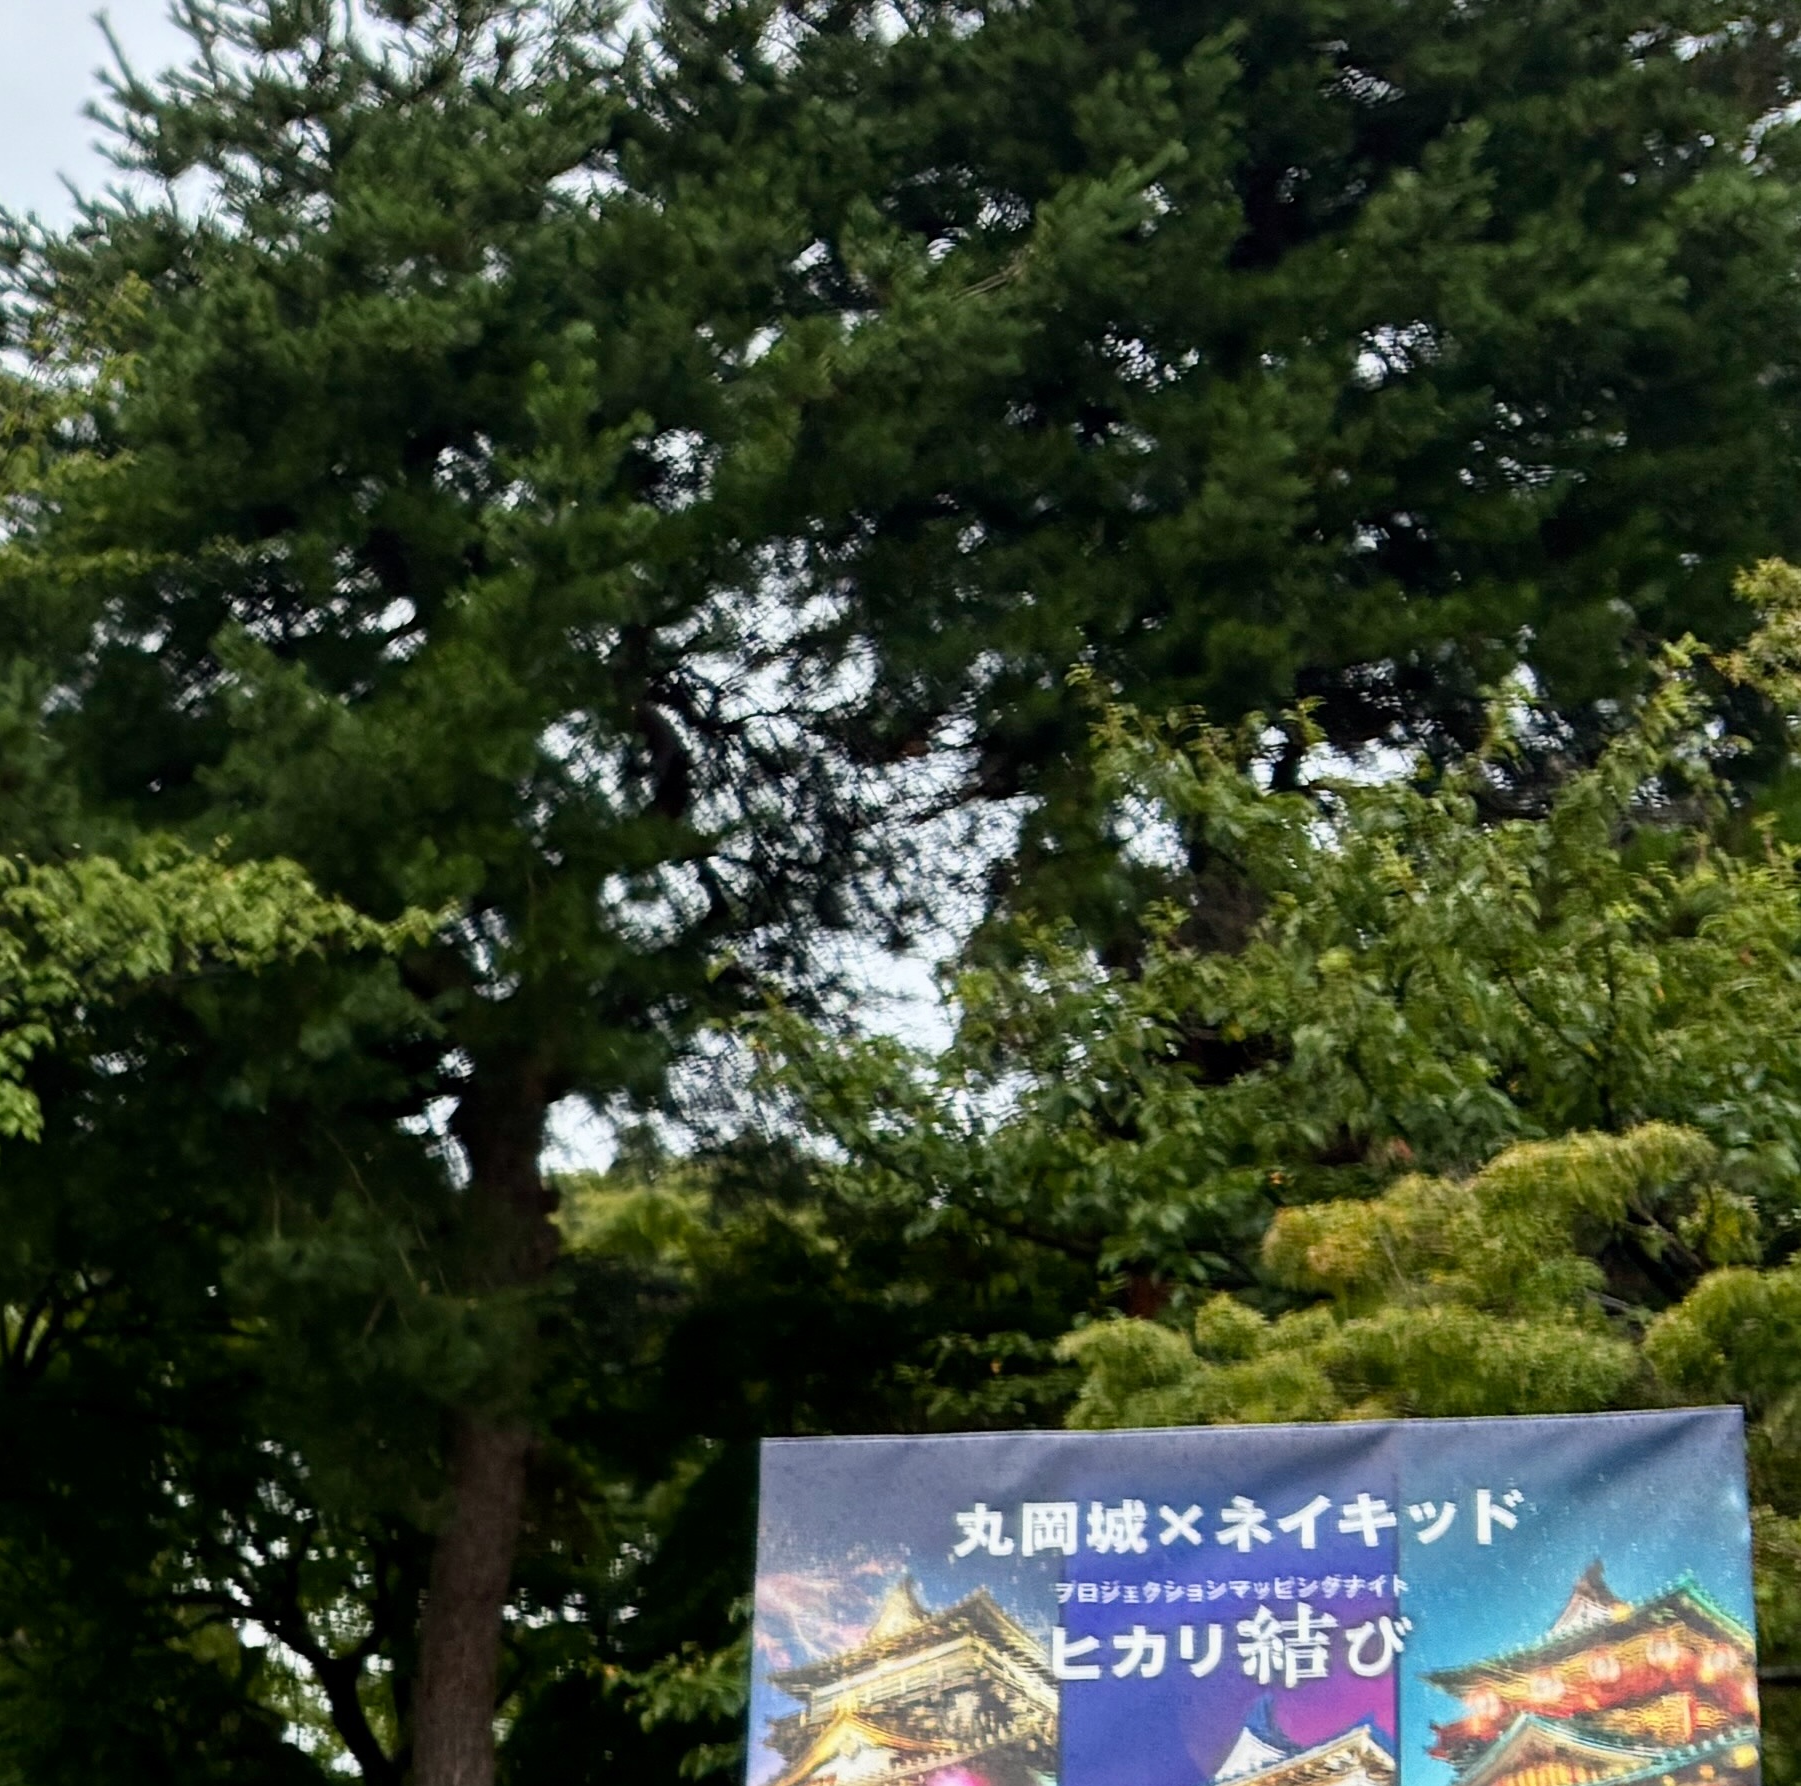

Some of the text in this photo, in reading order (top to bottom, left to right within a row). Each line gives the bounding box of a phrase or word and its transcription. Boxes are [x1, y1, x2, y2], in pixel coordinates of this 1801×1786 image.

[953, 1488, 1525, 1558] 丸岡城×ネイキッド
[1054, 1575, 1408, 1604] プロジェクションマッピングナイト
[1051, 1605, 1414, 1688] ヒカリ結び
